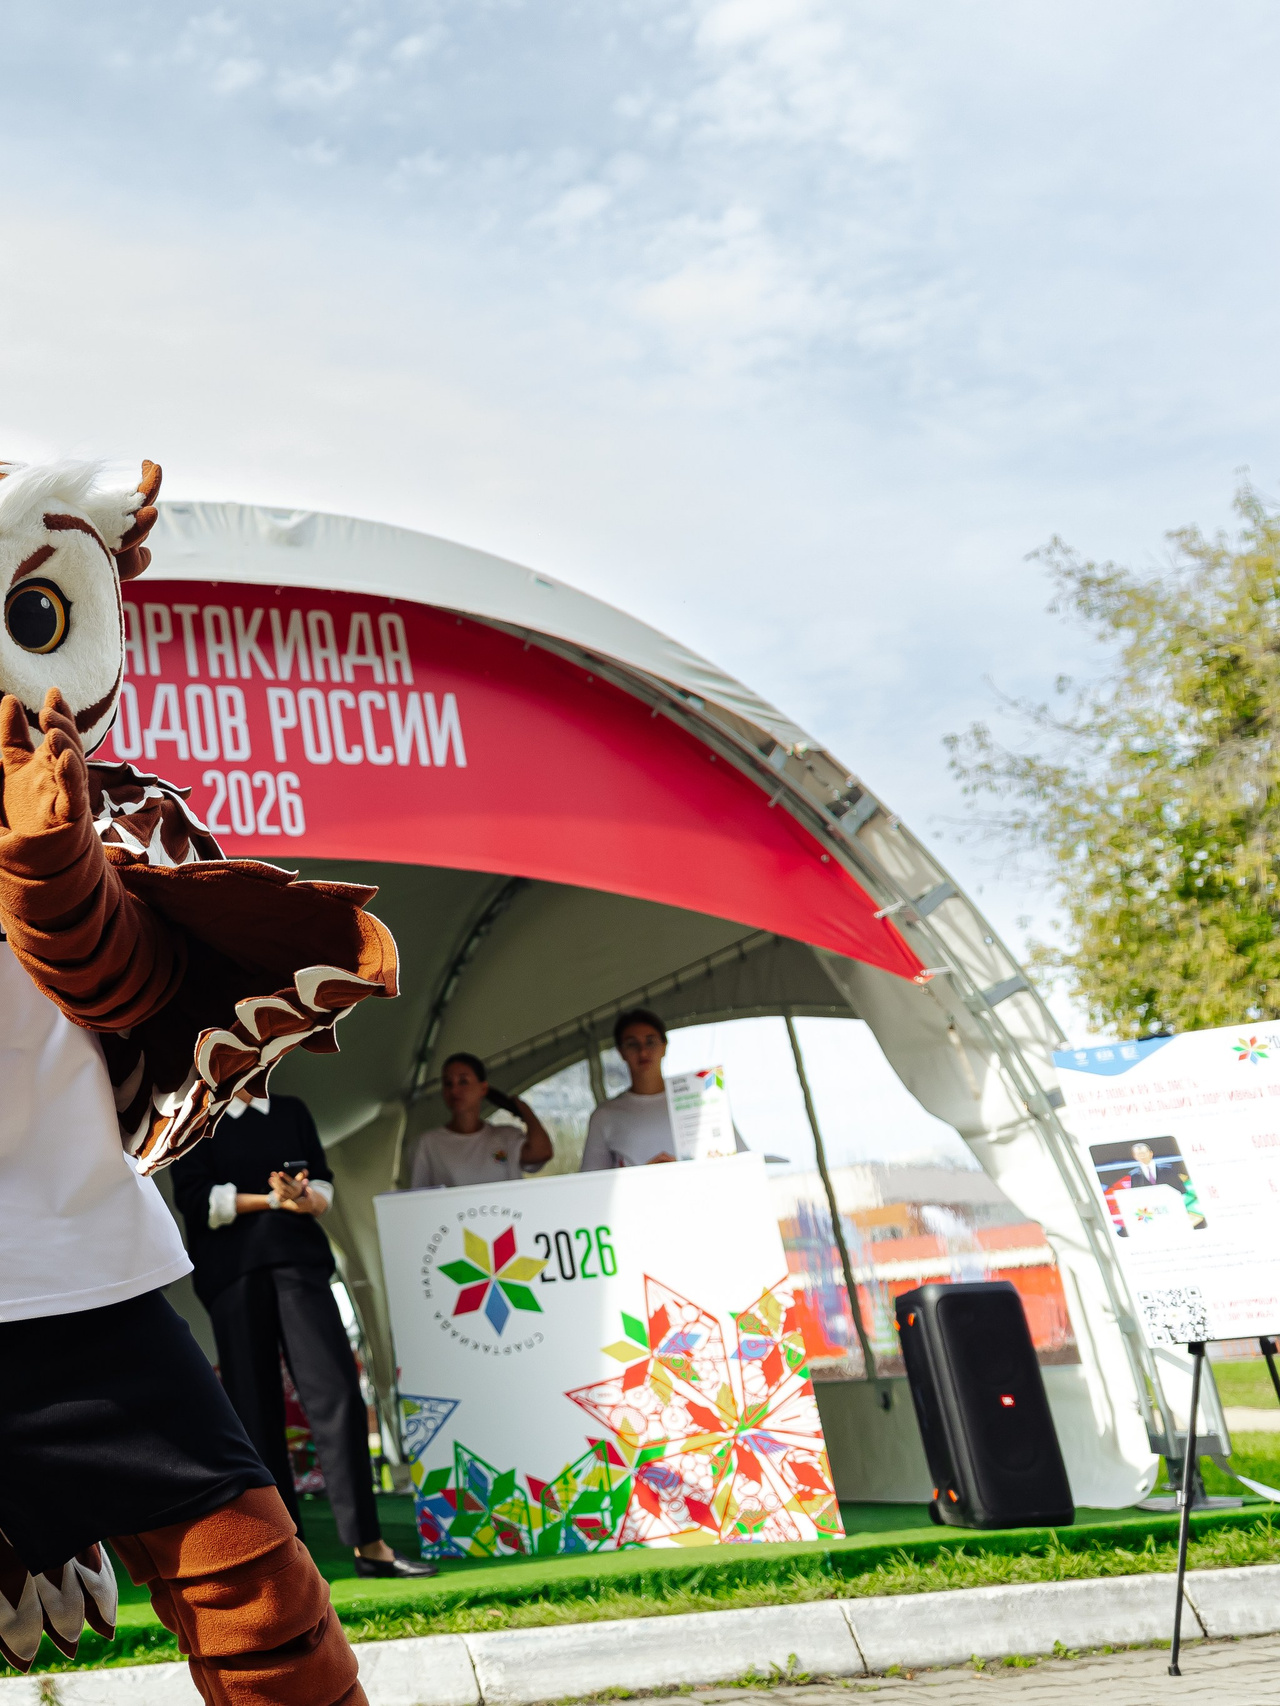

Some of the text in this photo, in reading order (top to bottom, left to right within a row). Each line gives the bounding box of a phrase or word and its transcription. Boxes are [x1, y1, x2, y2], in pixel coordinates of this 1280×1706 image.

[123, 601, 414, 686] АРТАКИАДА
[112, 682, 467, 768] ОДОВ РОССИИ
[202, 769, 306, 837] 2026
[456, 1204, 522, 1223] РОССИИ
[534, 1224, 618, 1283] 2026
[433, 1310, 544, 1356] СПАРТАКИАДА
